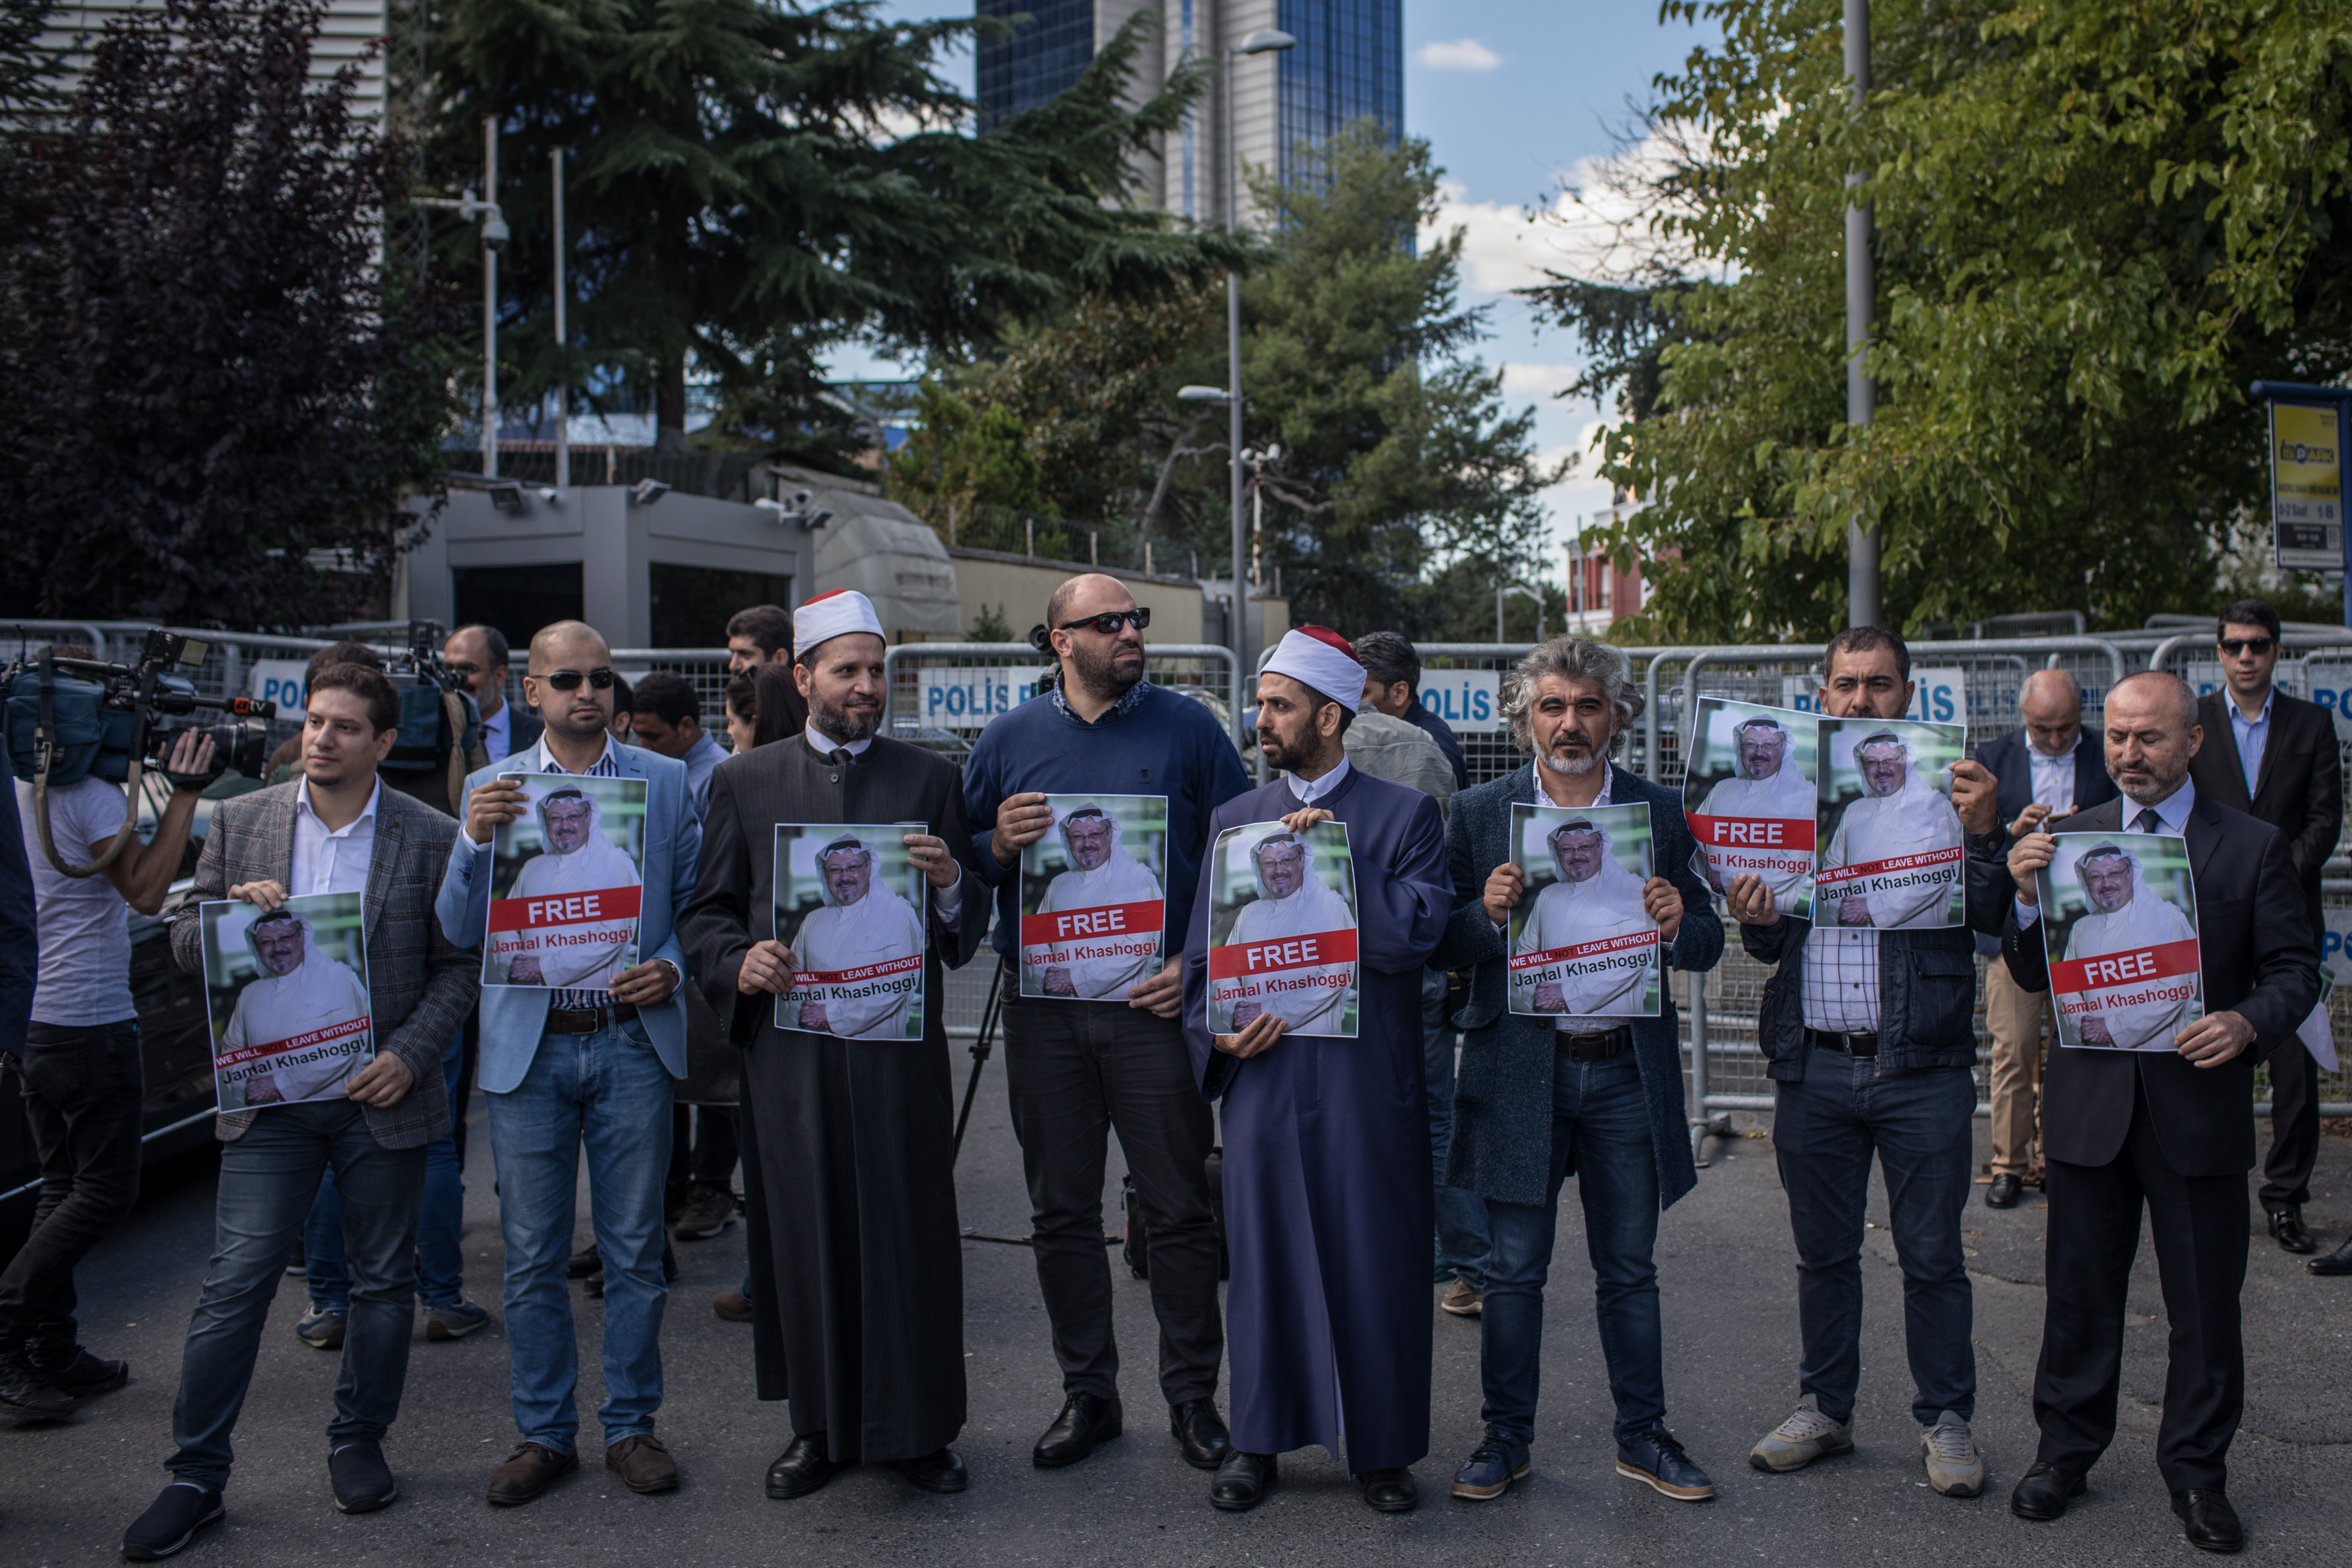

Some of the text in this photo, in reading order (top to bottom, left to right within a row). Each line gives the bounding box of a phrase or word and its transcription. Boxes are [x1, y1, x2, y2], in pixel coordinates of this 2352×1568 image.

[928, 678, 1008, 716] POLİS
[1714, 822, 1783, 844] FREE
[1726, 854, 1812, 874] Khashoggi
[1816, 849, 1960, 882] WE WILL NOT LEAVE WITHOUT
[1820, 867, 1956, 901] Jamal Khashoggi
[528, 894, 601, 924] FREE
[1057, 908, 1126, 937] FREE
[490, 925, 633, 953] Jamal Khashoggi
[1024, 939, 1157, 966] Jamal Khashoggi
[1247, 938, 1319, 970] FREE
[1510, 932, 1655, 967] WE WILL NOT LEAVE WITHOUT
[794, 973, 819, 982] WILL
[841, 966, 874, 981] LEAVE
[875, 957, 921, 976] WITHOUT
[1515, 948, 1653, 987] Jamal Khashoggi
[2083, 951, 2157, 985] FREE
[782, 973, 917, 1001] Jamal Khashoggi
[1213, 969, 1352, 1001] Jamal Khashoggi
[2060, 981, 2194, 1015] Jamal Khashoggi
[216, 1017, 368, 1067] WE WILL NOT LEAVE WITHOUT
[222, 1035, 366, 1085] Jamal Khashoggi
